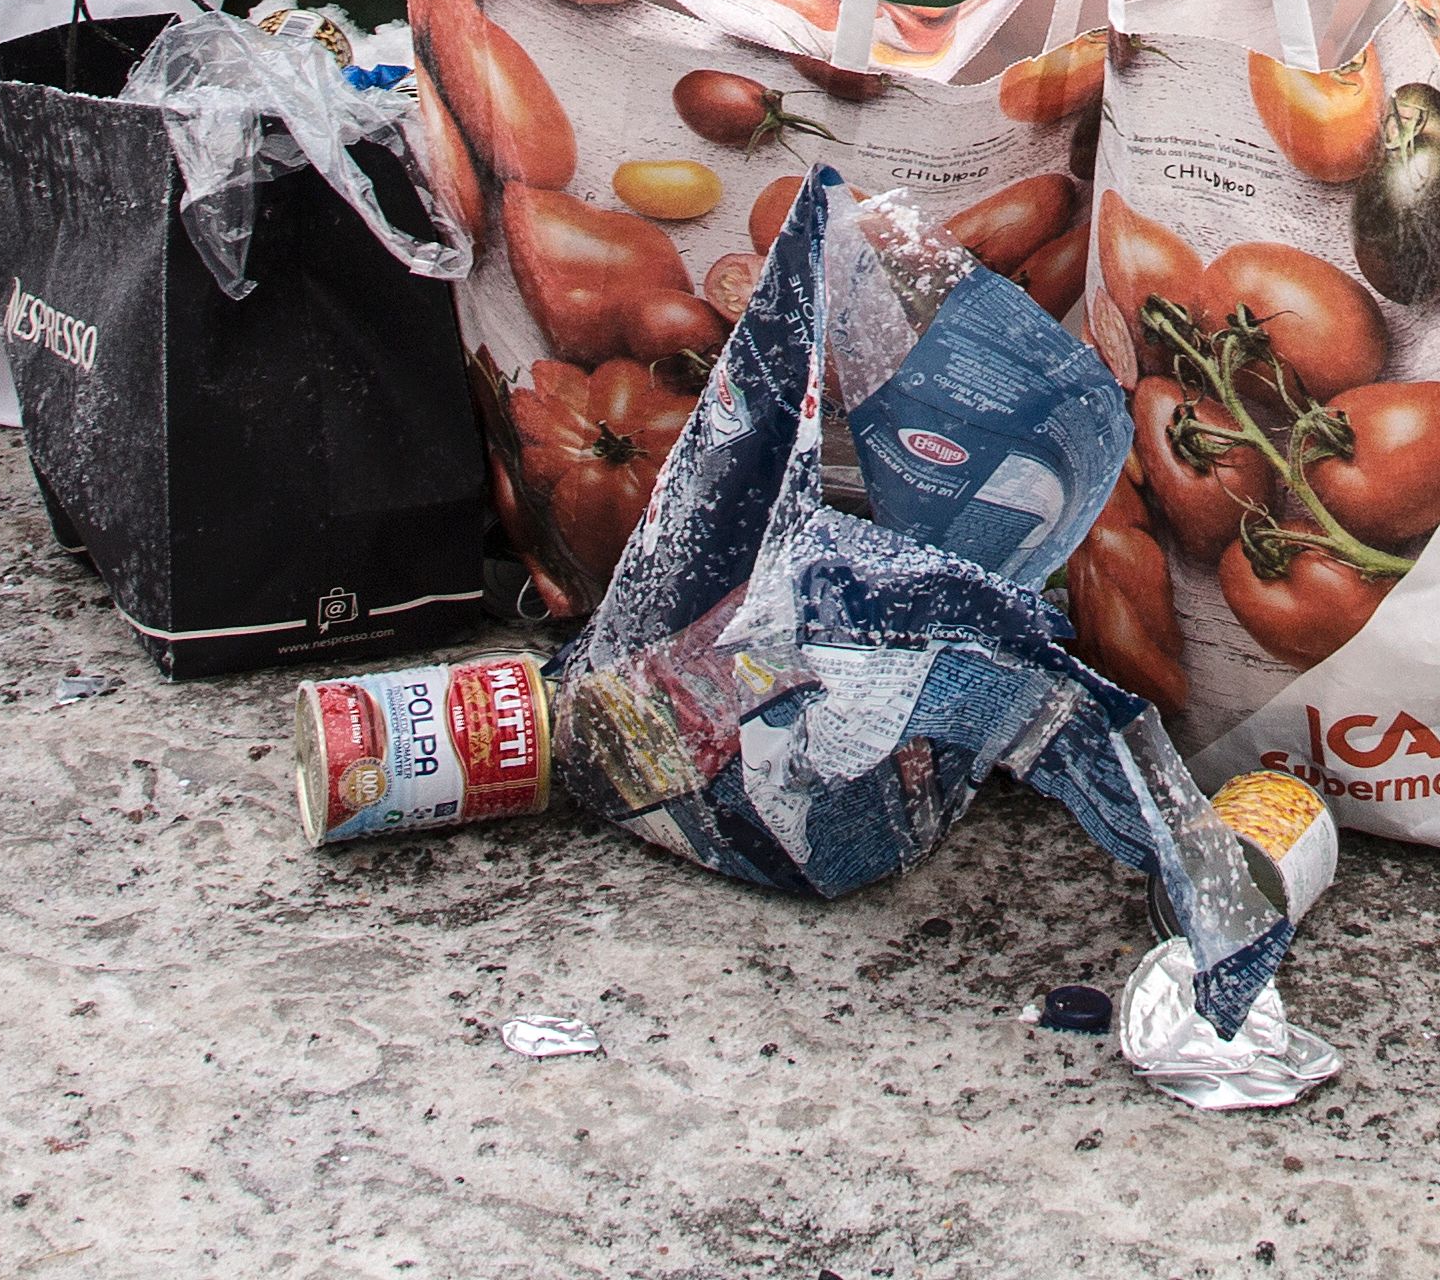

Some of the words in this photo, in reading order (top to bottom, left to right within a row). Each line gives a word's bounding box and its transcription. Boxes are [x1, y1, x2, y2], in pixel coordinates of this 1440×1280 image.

[891, 167, 989, 184] CHILDHOOD
[1163, 163, 1256, 198] CHILDHOOD
[3, 276, 98, 374] NESPRESSO
[277, 627, 395, 654] www.nespresso.com
[404, 681, 440, 778] POLPA
[487, 666, 528, 769] MUTTI
